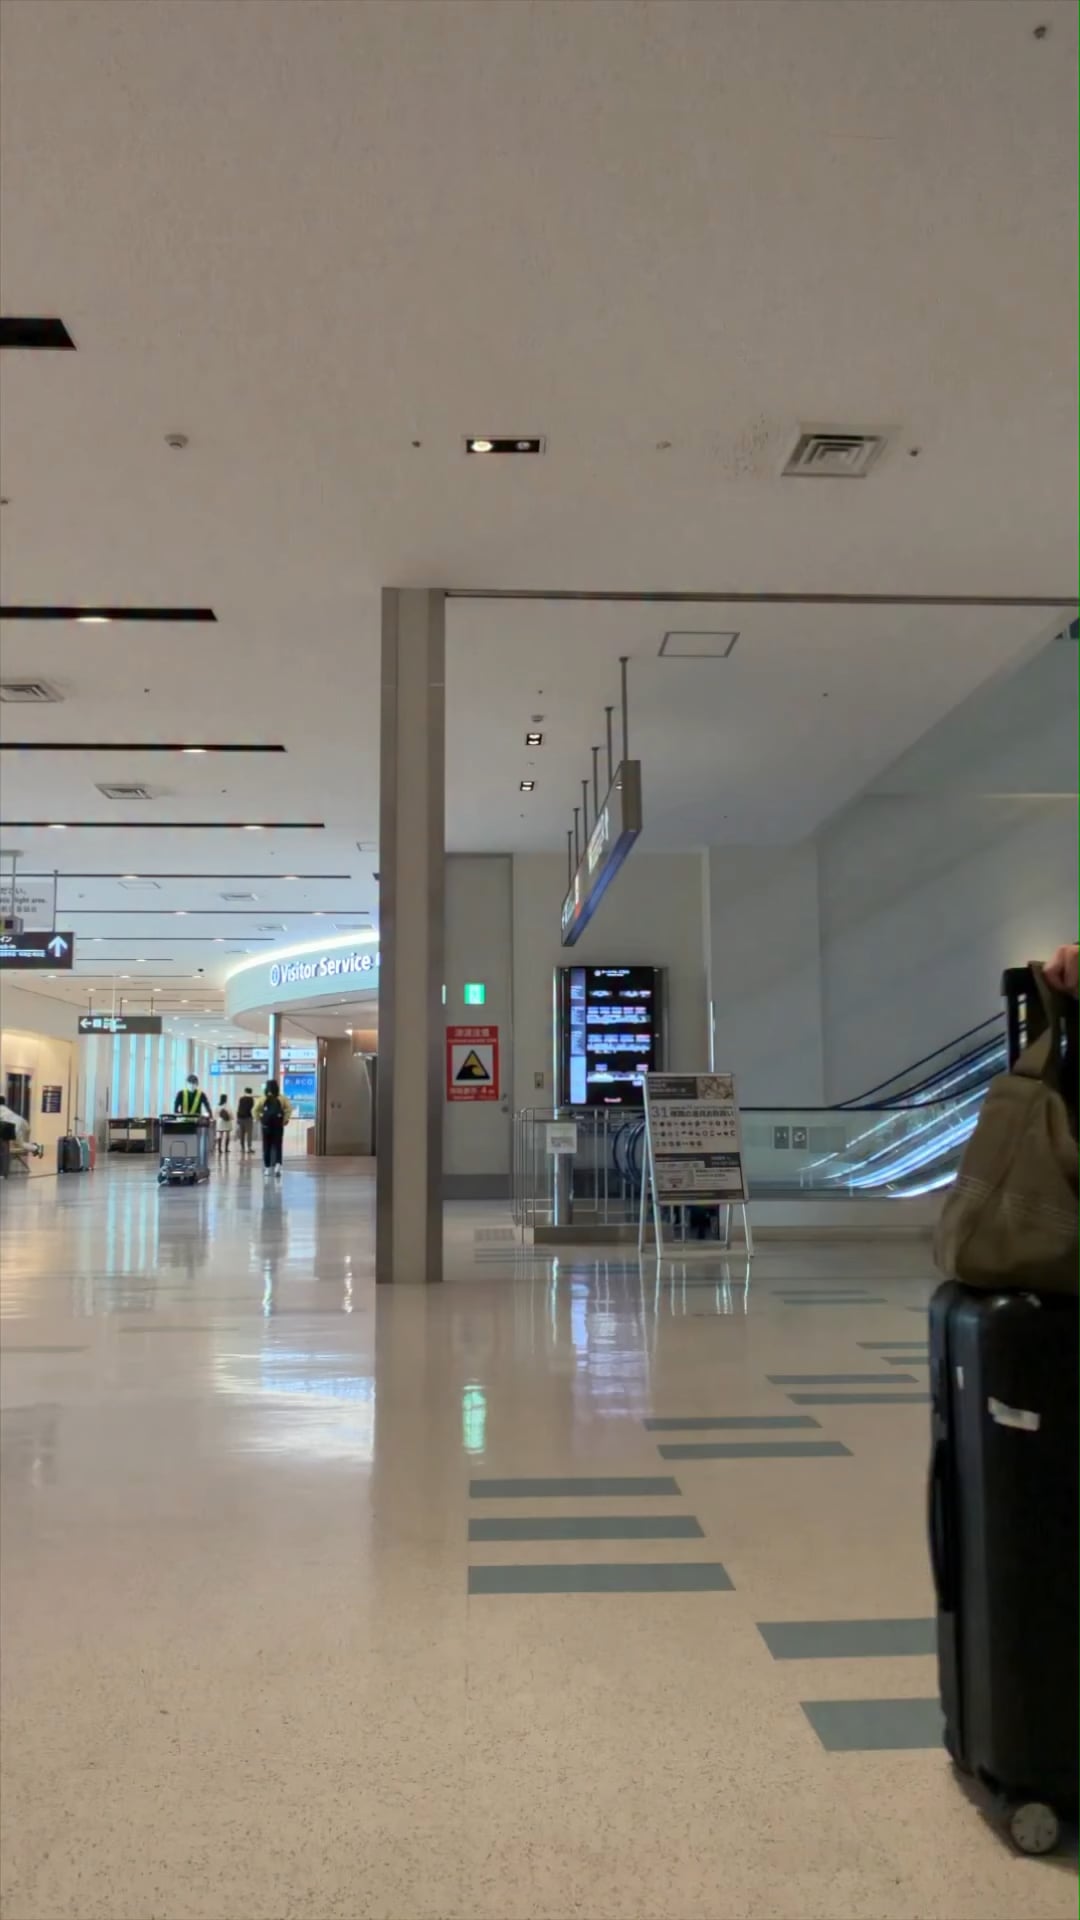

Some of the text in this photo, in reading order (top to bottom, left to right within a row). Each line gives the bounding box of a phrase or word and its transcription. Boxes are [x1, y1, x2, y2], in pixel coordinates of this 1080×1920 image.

[281, 961, 318, 983] Visitor
[320, 952, 371, 977] Service
[651, 1106, 668, 1118] 31
